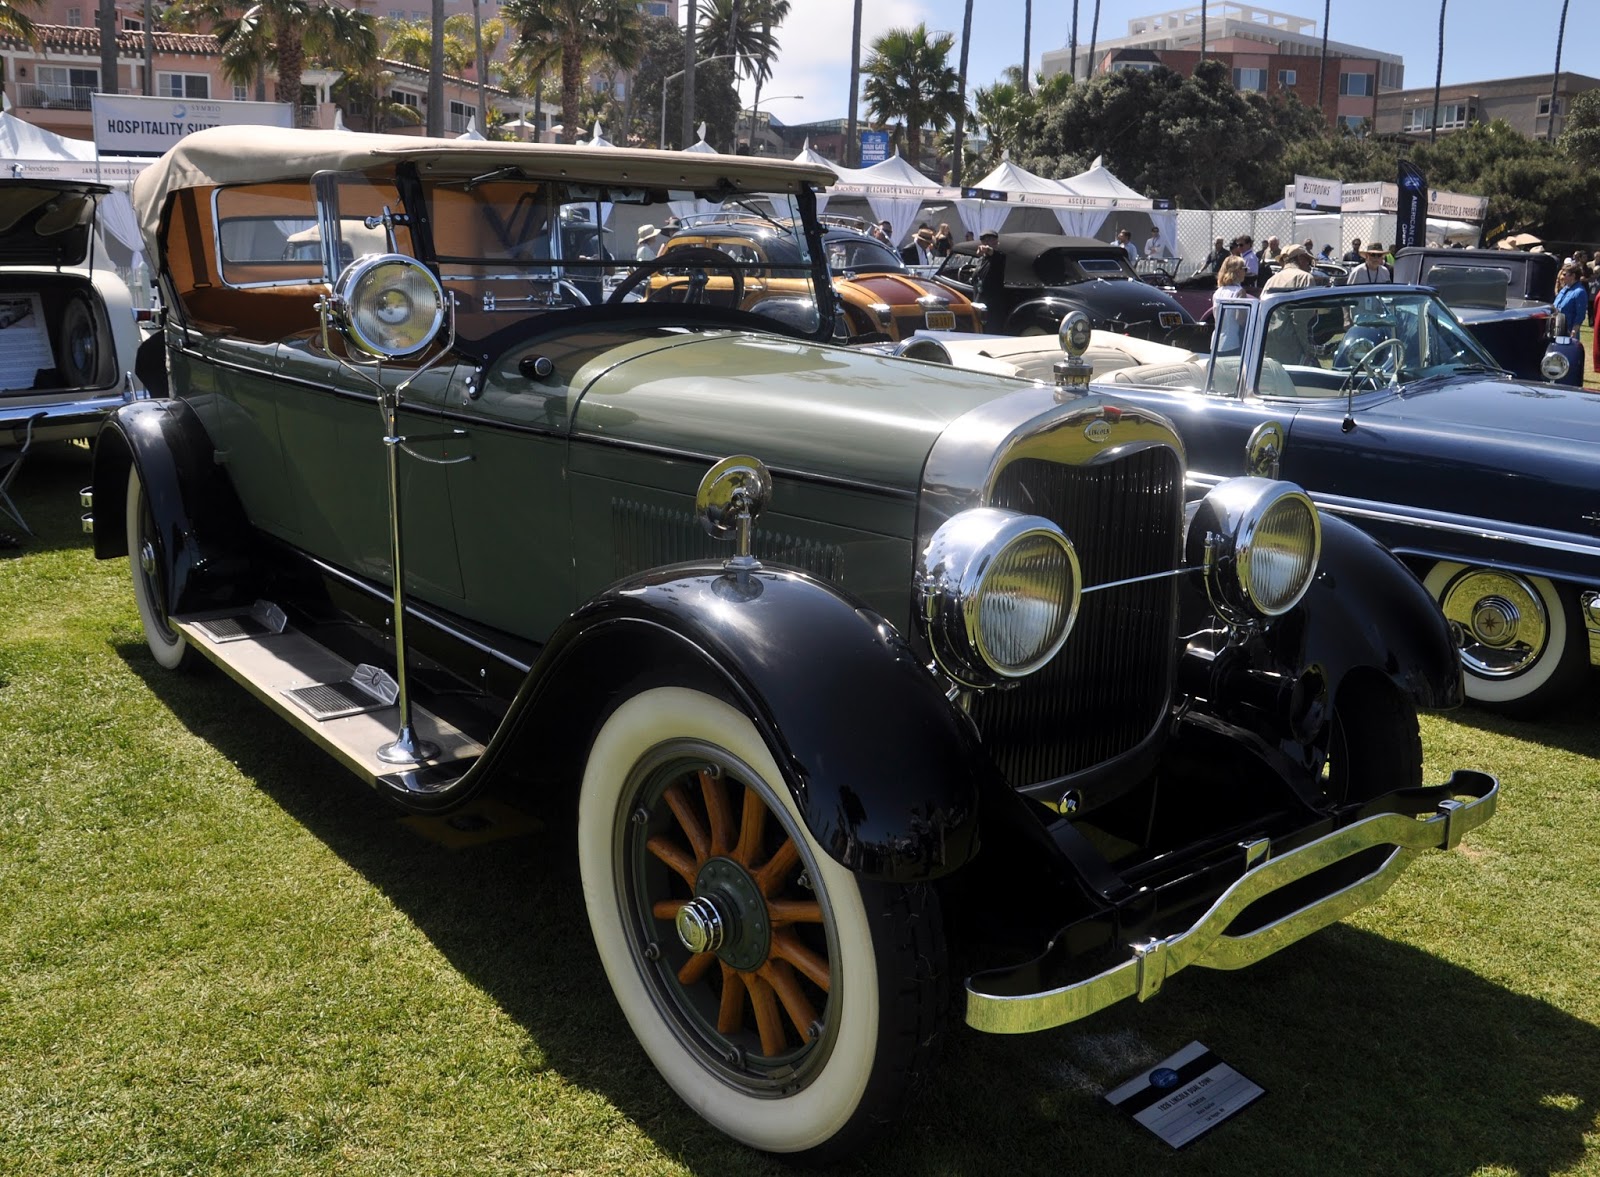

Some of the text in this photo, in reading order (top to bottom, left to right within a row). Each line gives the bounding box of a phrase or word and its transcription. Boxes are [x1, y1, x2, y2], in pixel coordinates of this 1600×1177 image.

[108, 119, 183, 136] HOSPITALITY
[1303, 182, 1331, 196] RESTROOMS
[1410, 196, 1418, 236] AMERICAN
[1168, 1090, 1190, 1105] LINCOLN
[1186, 1084, 1202, 1094] DUAL
